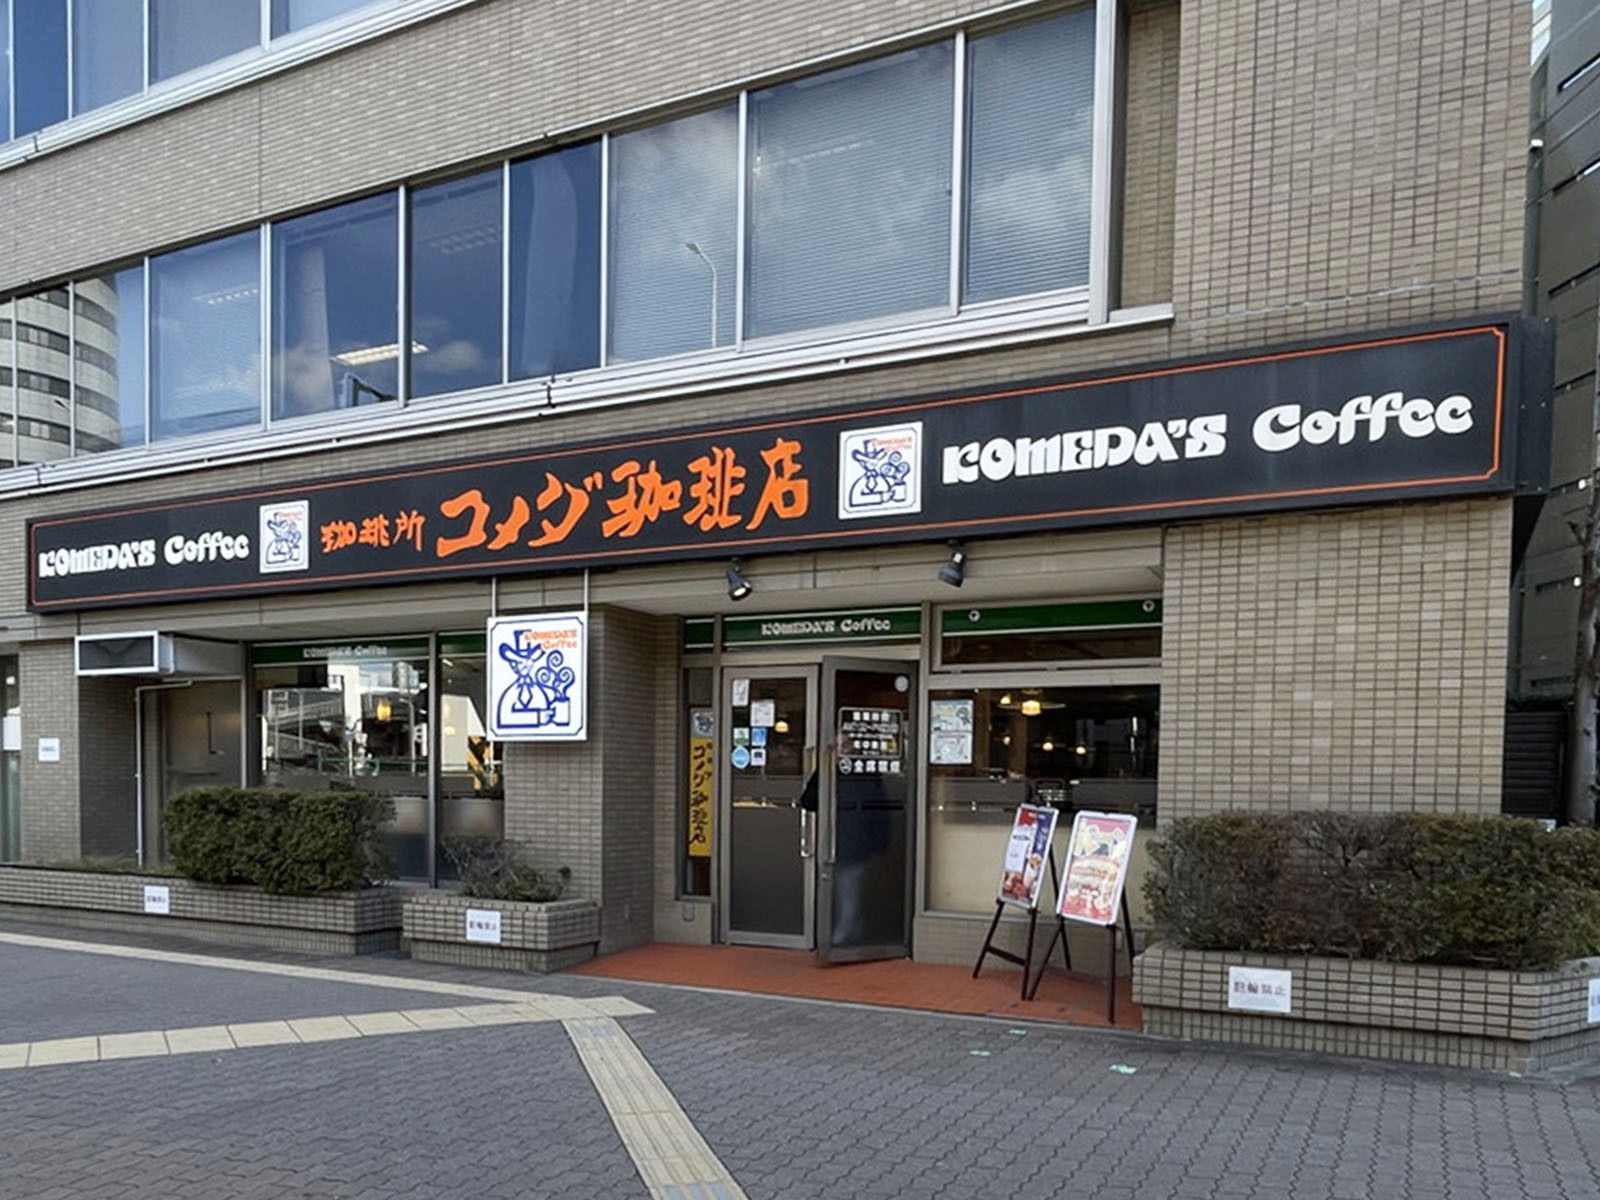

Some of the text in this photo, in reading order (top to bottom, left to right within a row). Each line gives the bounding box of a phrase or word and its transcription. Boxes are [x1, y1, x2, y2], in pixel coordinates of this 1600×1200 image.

[943, 392, 1473, 484] KOMEDA'S Coffee
[320, 438, 809, 558] 珈琲所 コメダ珈琲店
[38, 531, 250, 578] KOMEDA'S Coffee
[840, 618, 891, 632] Coffee
